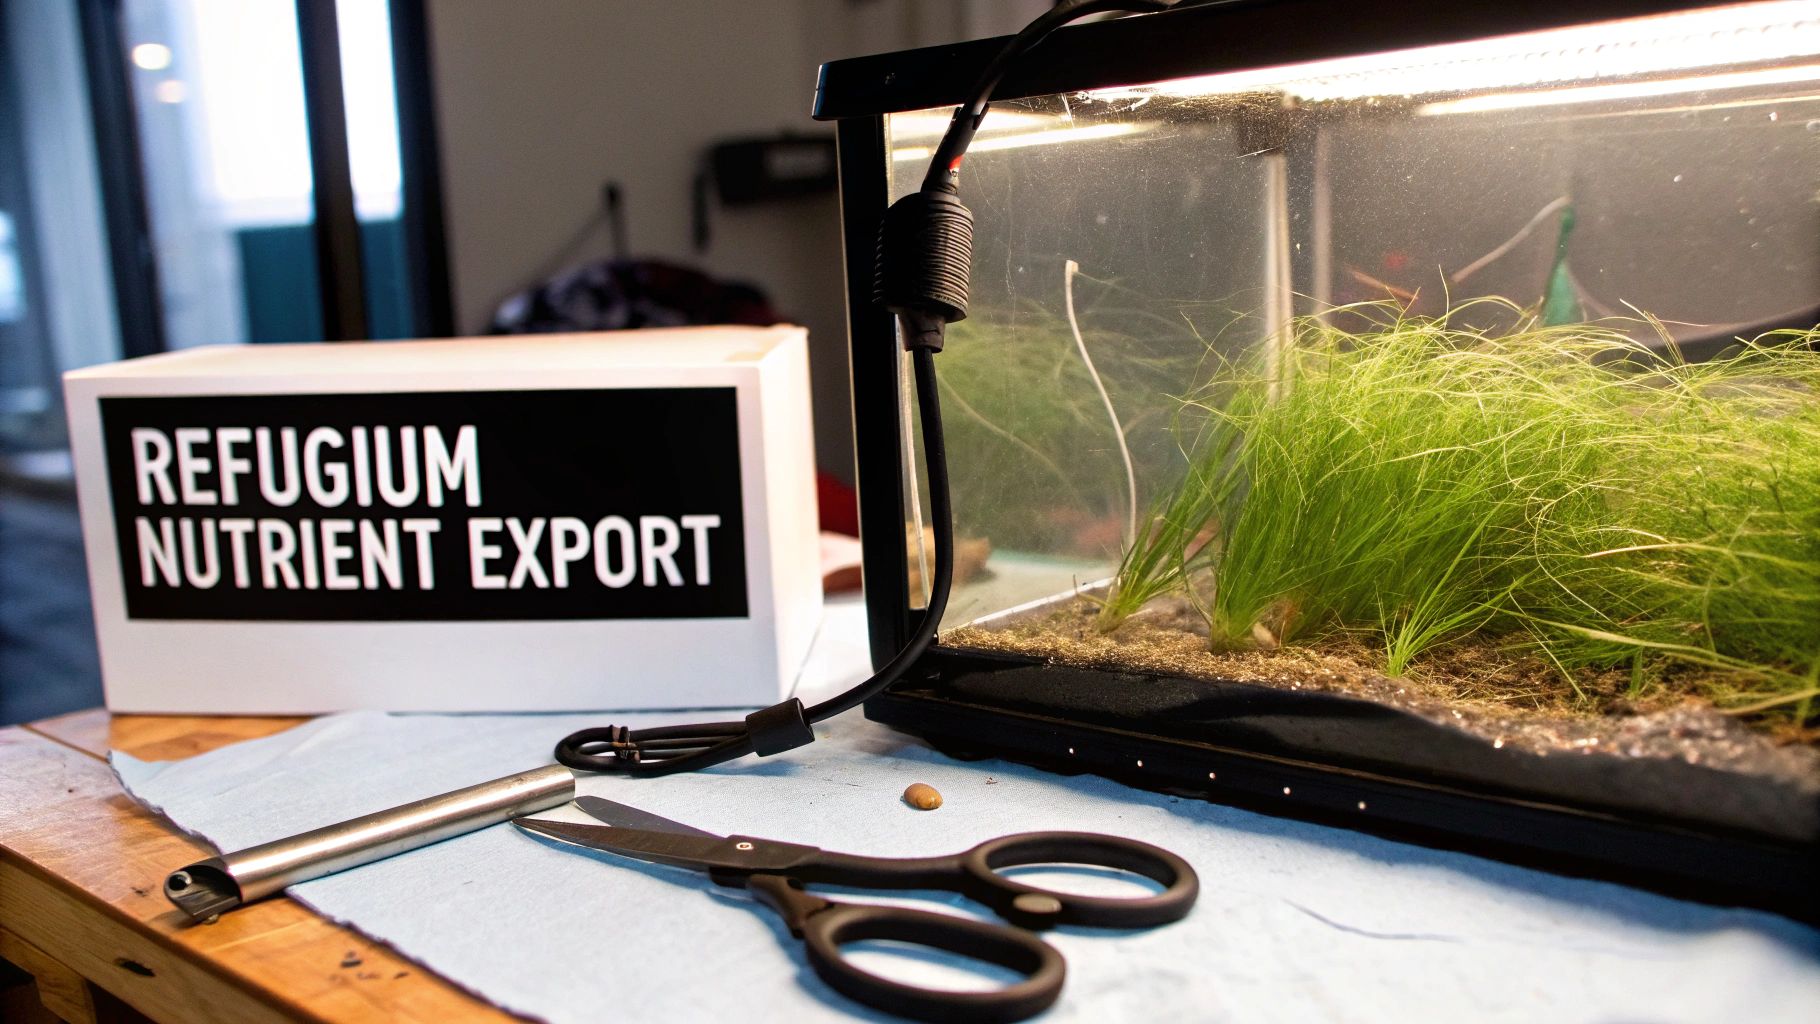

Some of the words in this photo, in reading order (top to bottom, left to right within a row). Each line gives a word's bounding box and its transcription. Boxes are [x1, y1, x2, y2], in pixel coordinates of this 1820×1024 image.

[132, 425, 481, 508] REFUGIUM
[136, 518, 441, 590] NUTRIENT
[468, 515, 721, 589] EXPORT
